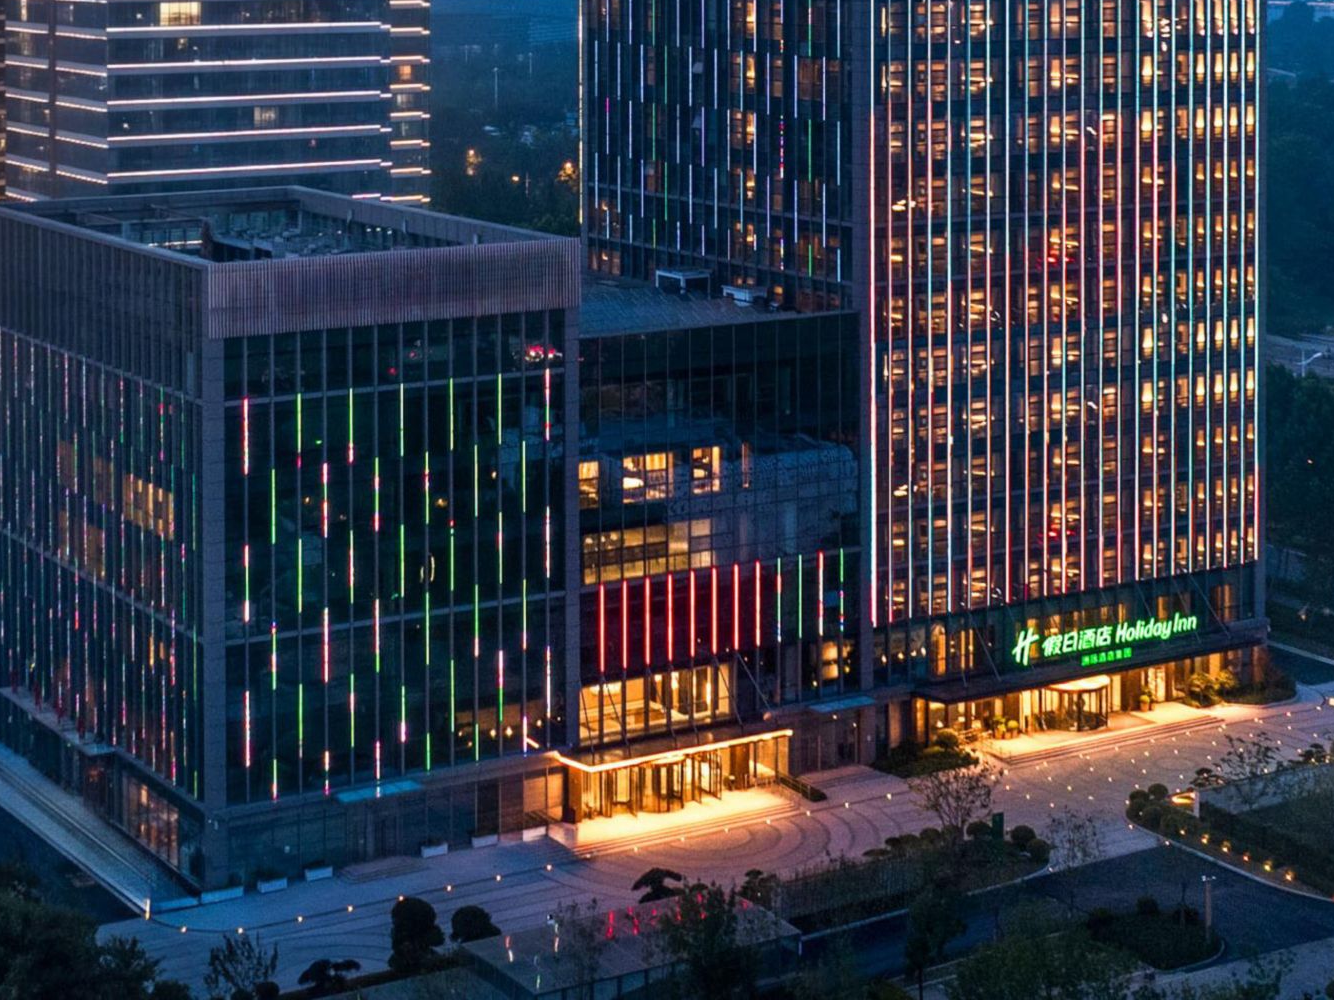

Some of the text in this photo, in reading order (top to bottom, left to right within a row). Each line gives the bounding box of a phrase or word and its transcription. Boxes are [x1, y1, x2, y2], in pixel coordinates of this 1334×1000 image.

[1042, 625, 1113, 657] 假日酒店
[1115, 617, 1172, 643] Holiday
[1173, 612, 1197, 633] Inn
